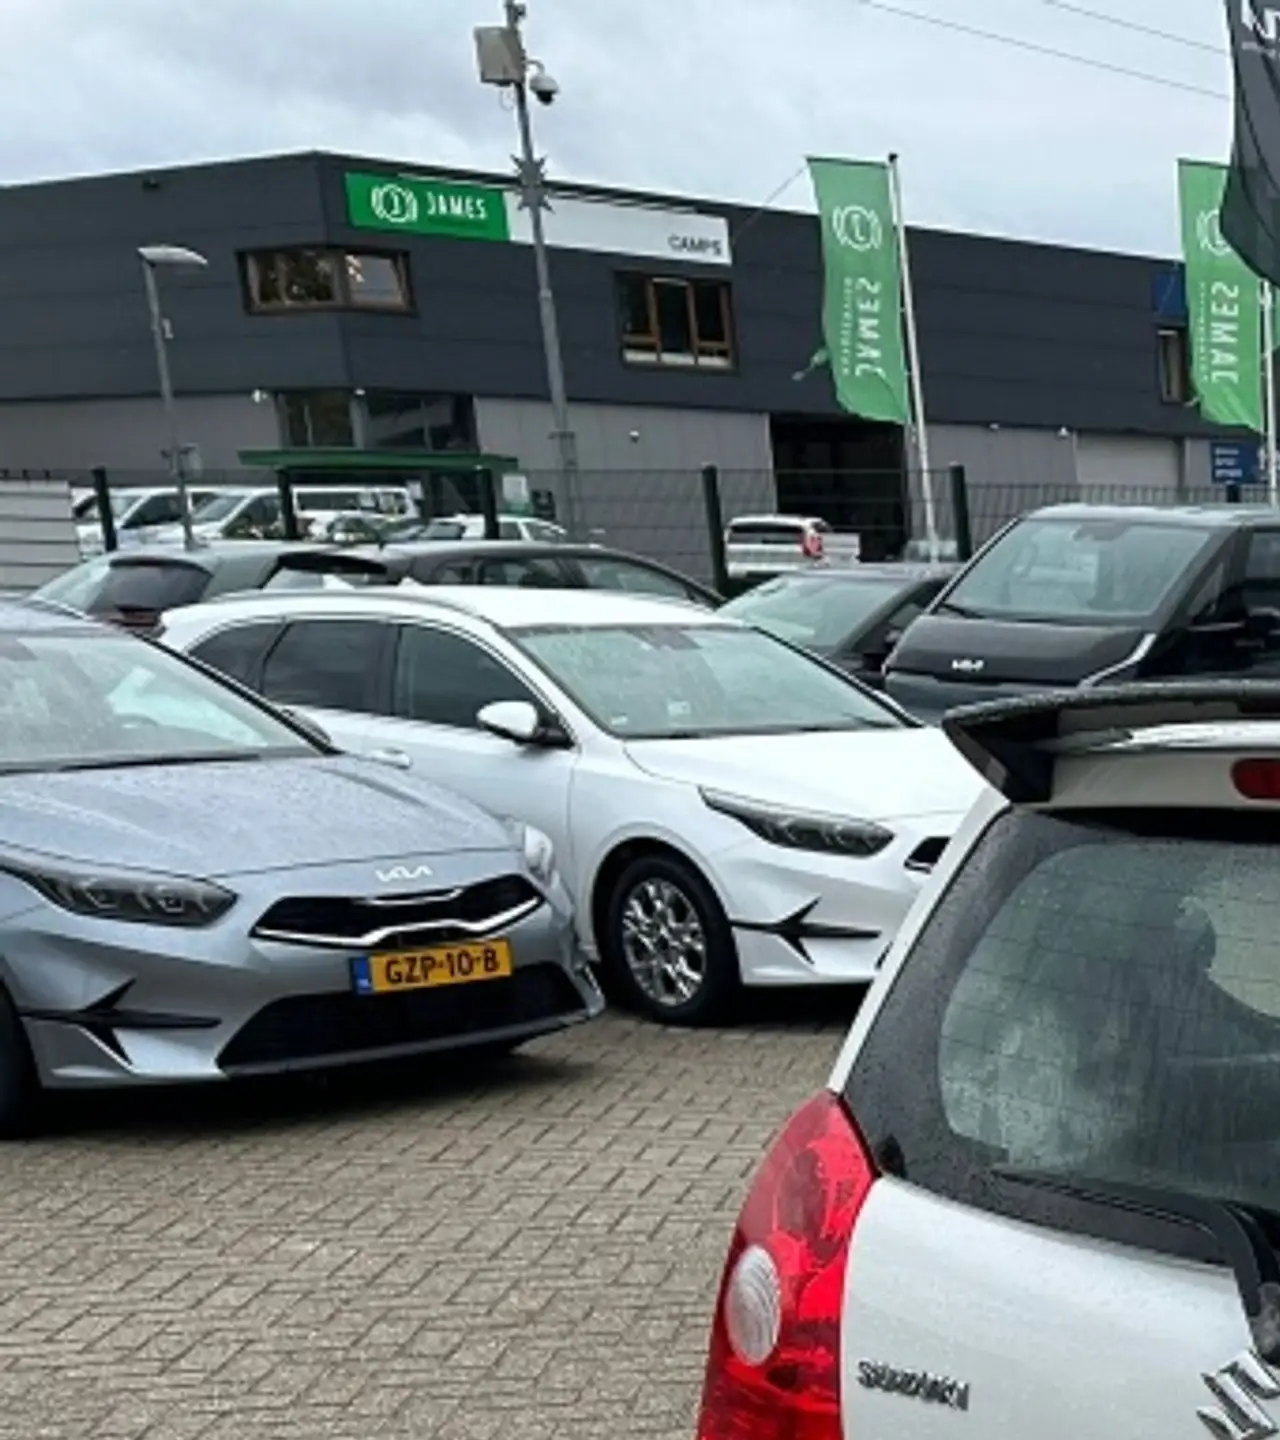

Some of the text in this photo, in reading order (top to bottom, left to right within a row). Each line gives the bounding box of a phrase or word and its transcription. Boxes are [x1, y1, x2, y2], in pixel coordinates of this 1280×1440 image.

[426, 191, 487, 221] JAMES
[667, 232, 722, 256] CAMPS
[384, 946, 500, 985] GZP-10-B
[857, 1359, 970, 1412] SUZUKI
